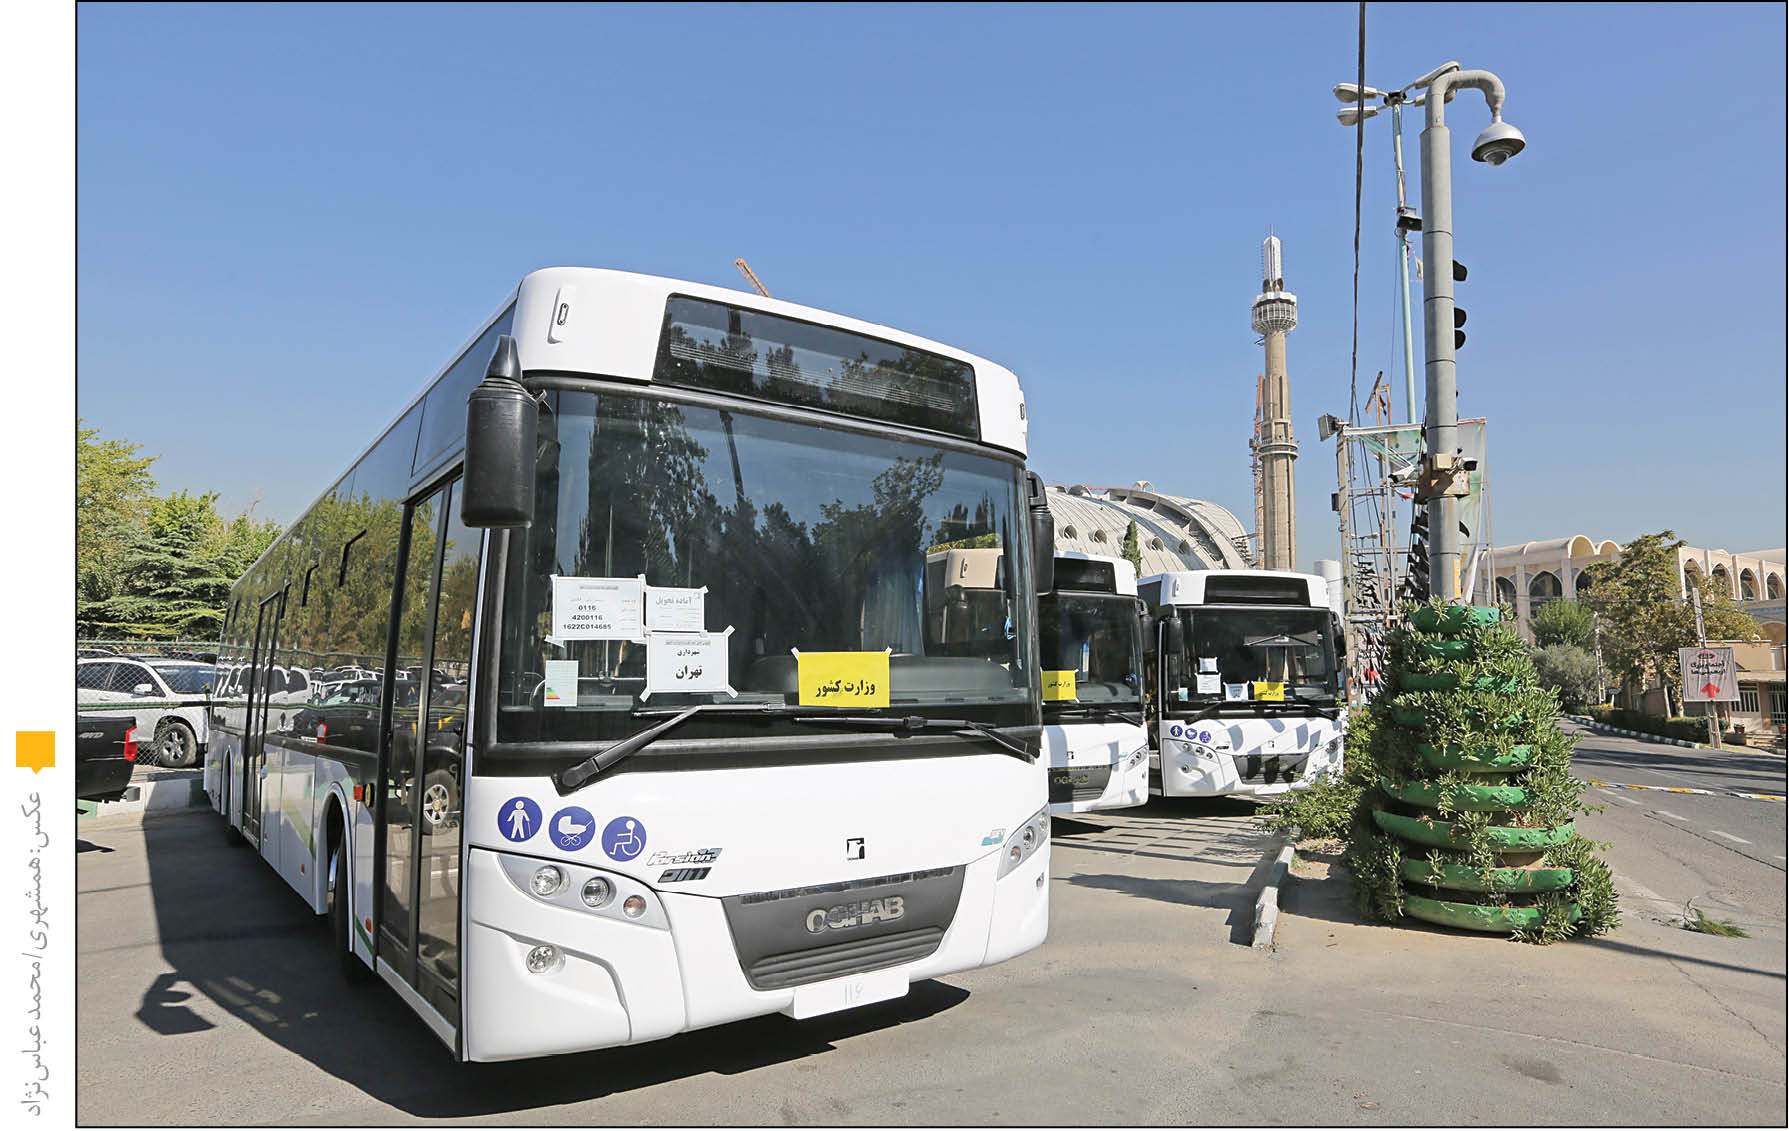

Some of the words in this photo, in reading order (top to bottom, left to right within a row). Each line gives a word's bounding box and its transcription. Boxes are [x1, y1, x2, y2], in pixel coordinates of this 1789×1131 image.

[675, 665, 703, 680] تهران
[815, 680, 842, 698] کشور
[844, 680, 876, 696] وزارت
[806, 895, 905, 932] OGHAB
